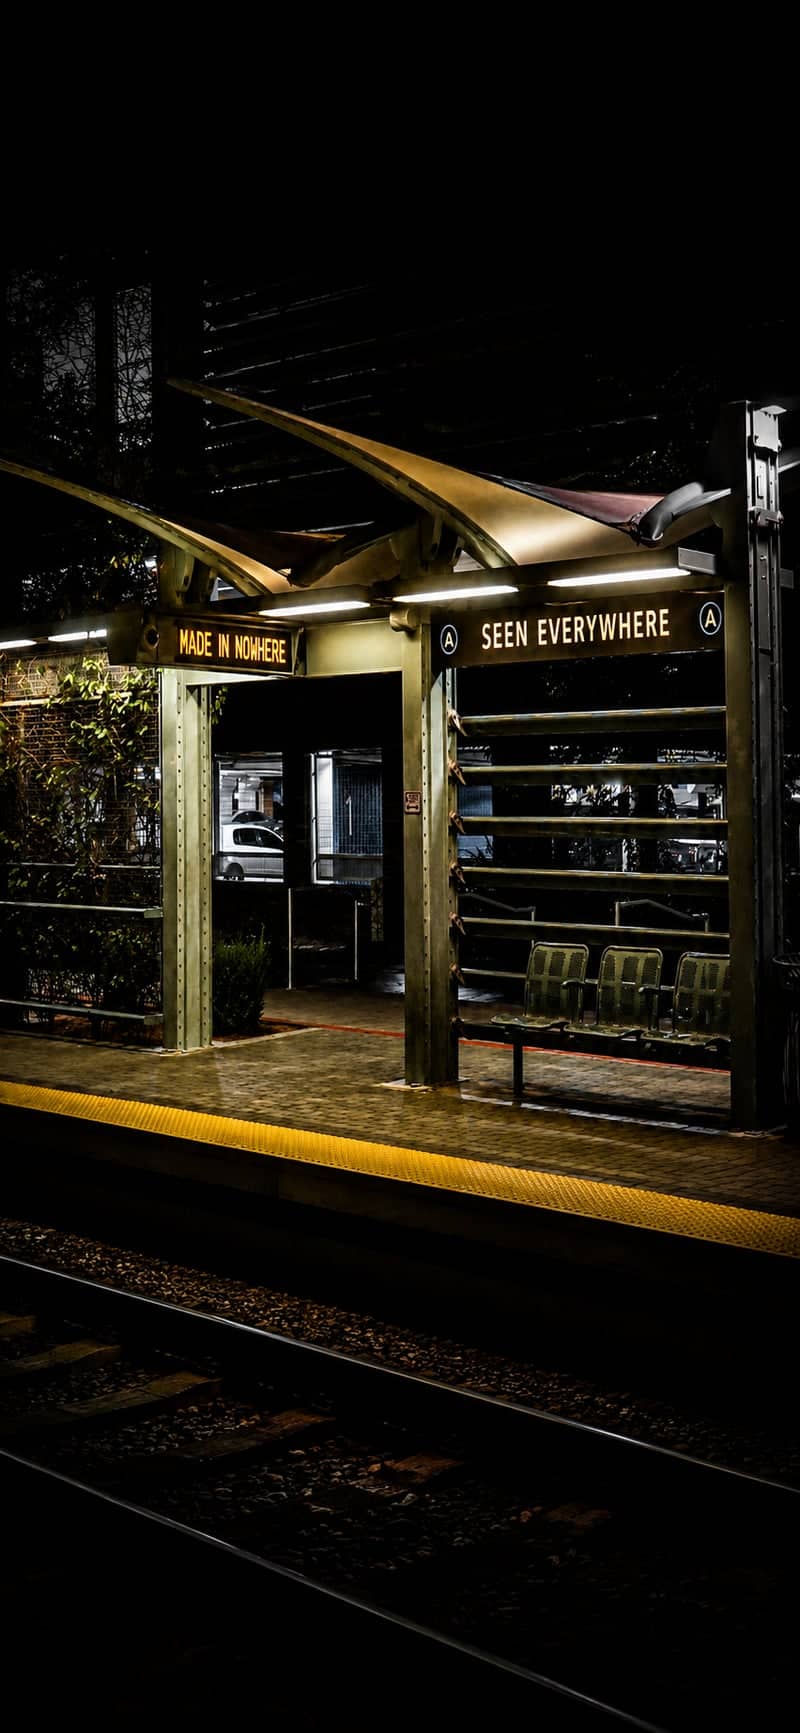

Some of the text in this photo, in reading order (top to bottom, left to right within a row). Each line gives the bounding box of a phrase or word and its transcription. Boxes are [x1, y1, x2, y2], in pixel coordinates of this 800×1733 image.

[481, 608, 670, 650] SEEN EVERYWHERE
[704, 608, 717, 628] A
[180, 628, 286, 664] MADE IN NOWHERE
[444, 631, 454, 648] A
